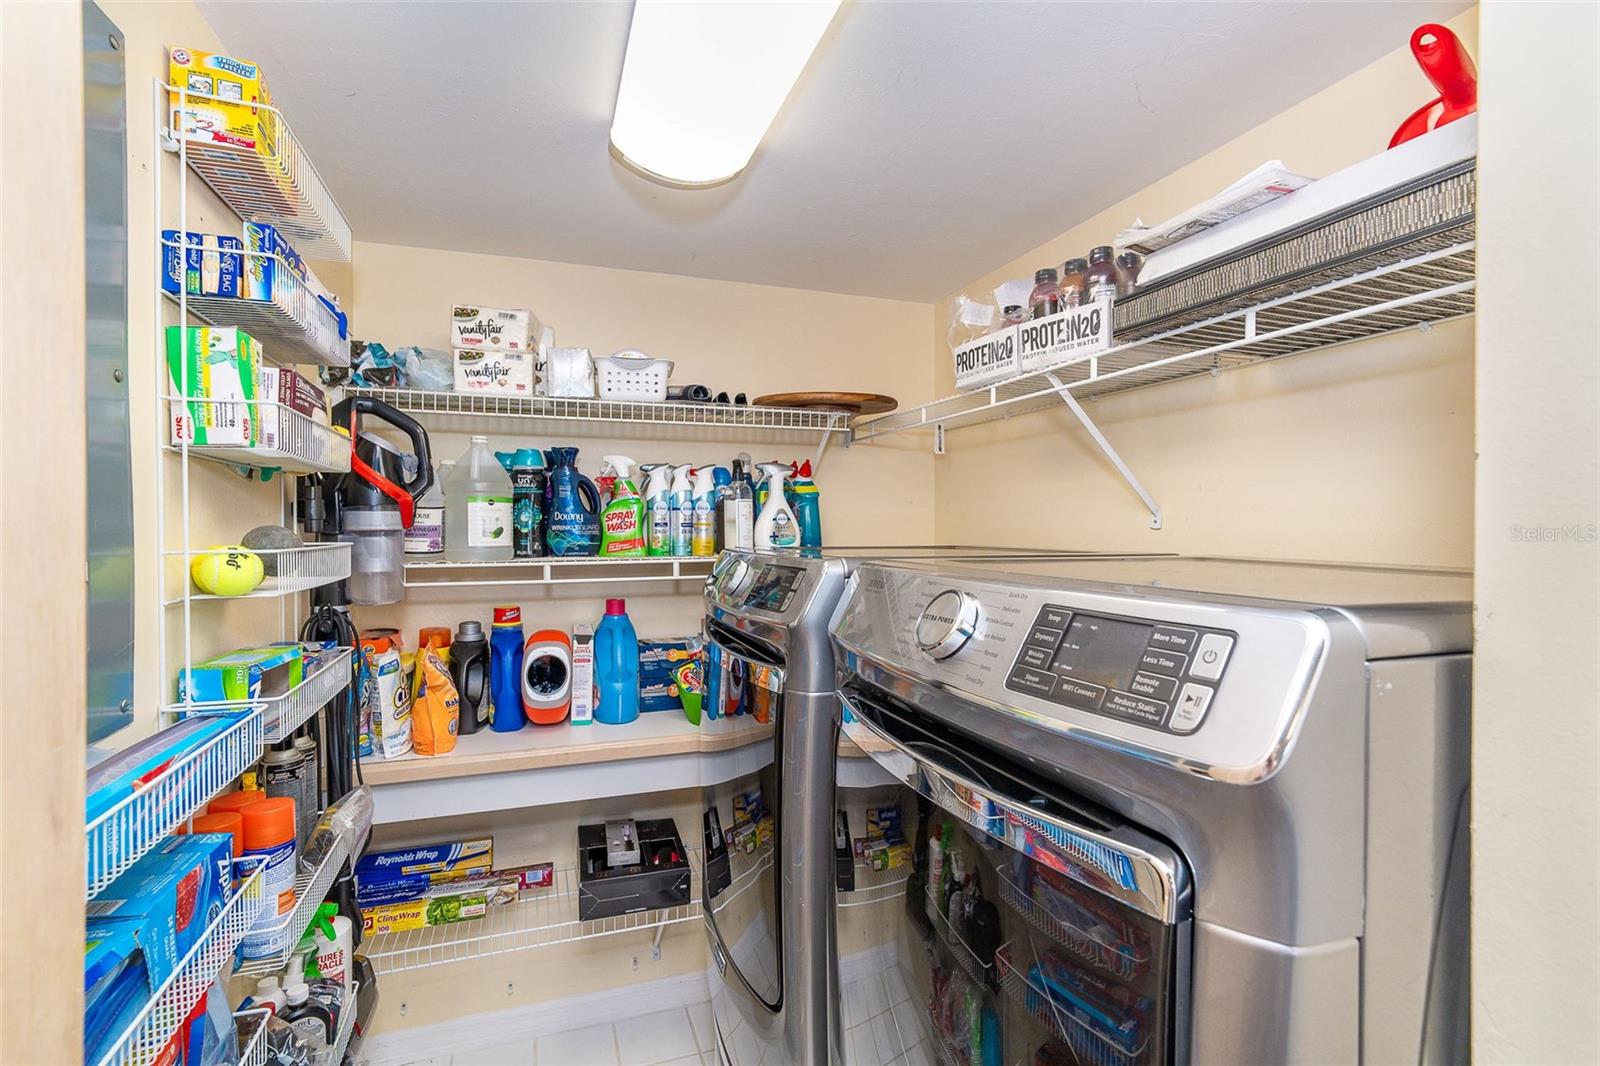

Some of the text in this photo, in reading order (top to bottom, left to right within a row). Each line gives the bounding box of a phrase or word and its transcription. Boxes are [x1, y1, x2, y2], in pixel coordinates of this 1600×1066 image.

[223, 274, 232, 292] BAG
[1076, 337, 1100, 347] WATER
[554, 511, 584, 523] Downy
[605, 510, 635, 522] SPRAY
[607, 520, 637, 532] WASH
[1048, 613, 1062, 623] Temp
[1034, 632, 1054, 642] Dryness
[1152, 632, 1187, 645] More Time
[1025, 656, 1042, 665] Prevent
[1027, 650, 1045, 659] Wrinkle
[1142, 655, 1176, 668] Less Time
[1024, 673, 1040, 683] Steam
[1134, 674, 1161, 687] Remote
[1074, 687, 1097, 698] Connect
[1131, 682, 1154, 694] Enable
[1112, 695, 1158, 713] Reduce Static
[375, 849, 438, 867] Reynolds Wrap
[217, 852, 232, 904] Ziplo
[377, 911, 421, 923] Cling Wrap
